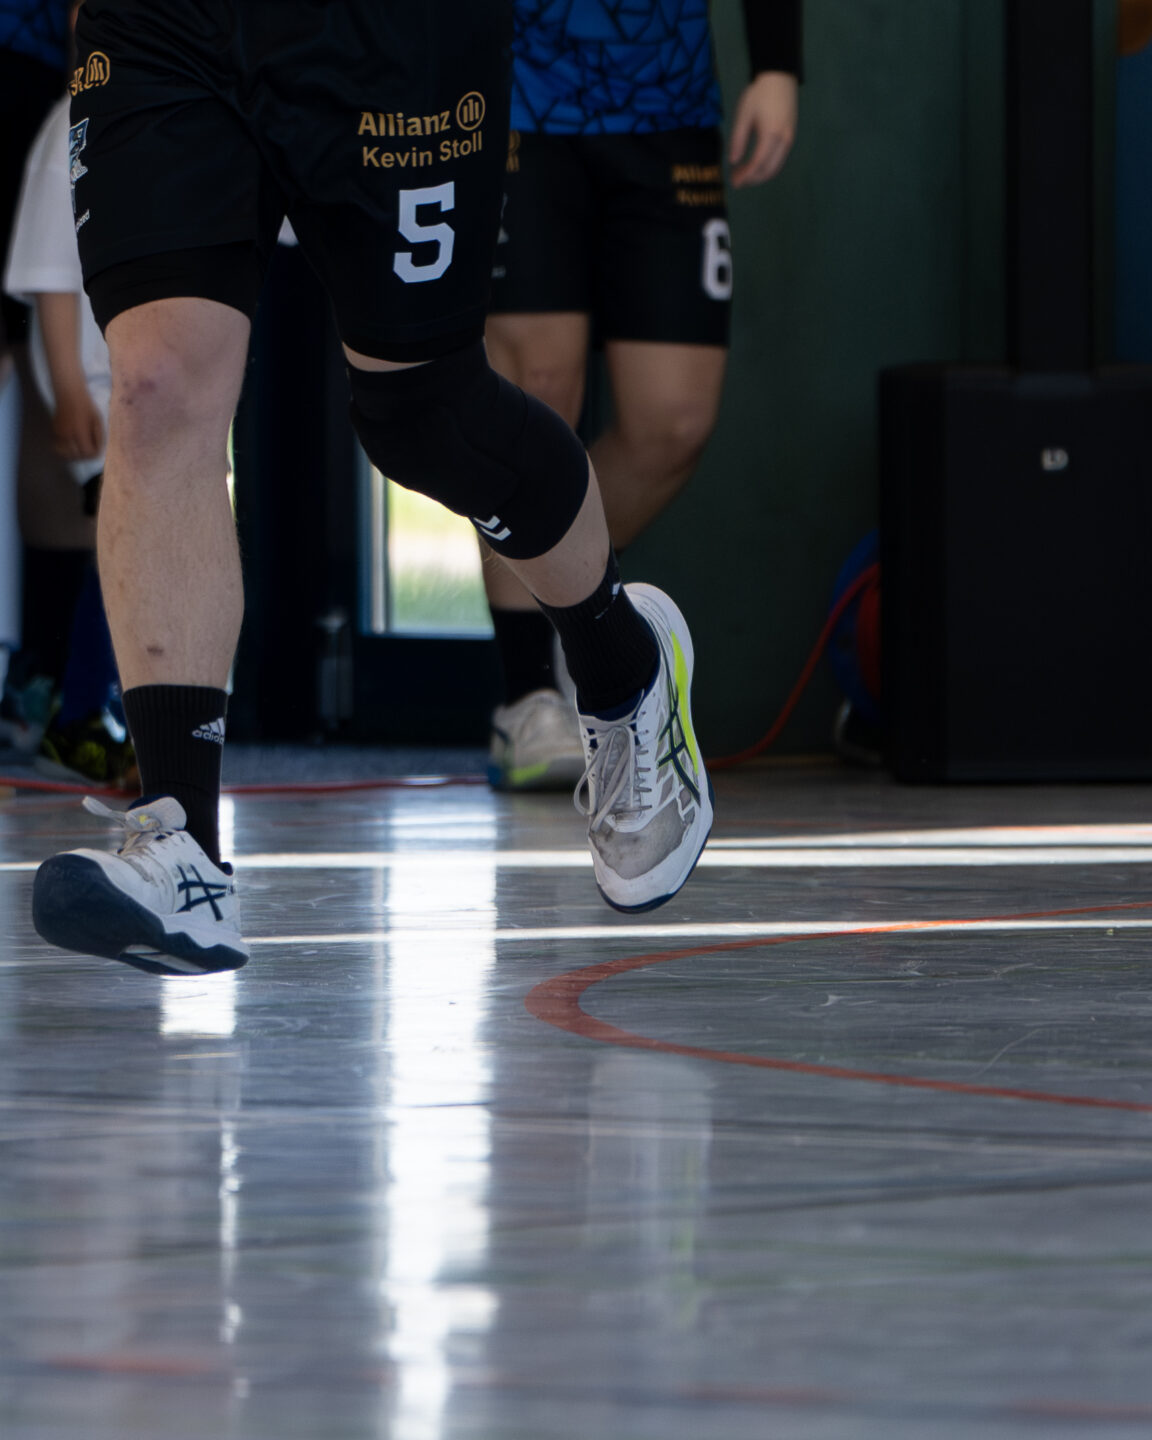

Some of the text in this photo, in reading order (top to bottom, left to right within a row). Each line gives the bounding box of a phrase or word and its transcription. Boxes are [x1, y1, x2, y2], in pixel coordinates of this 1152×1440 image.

[357, 109, 452, 137] Allianz
[362, 129, 483, 168] Kevin Stoll
[393, 180, 456, 284] 5
[701, 217, 733, 302] 6
[191, 729, 226, 745] adida
